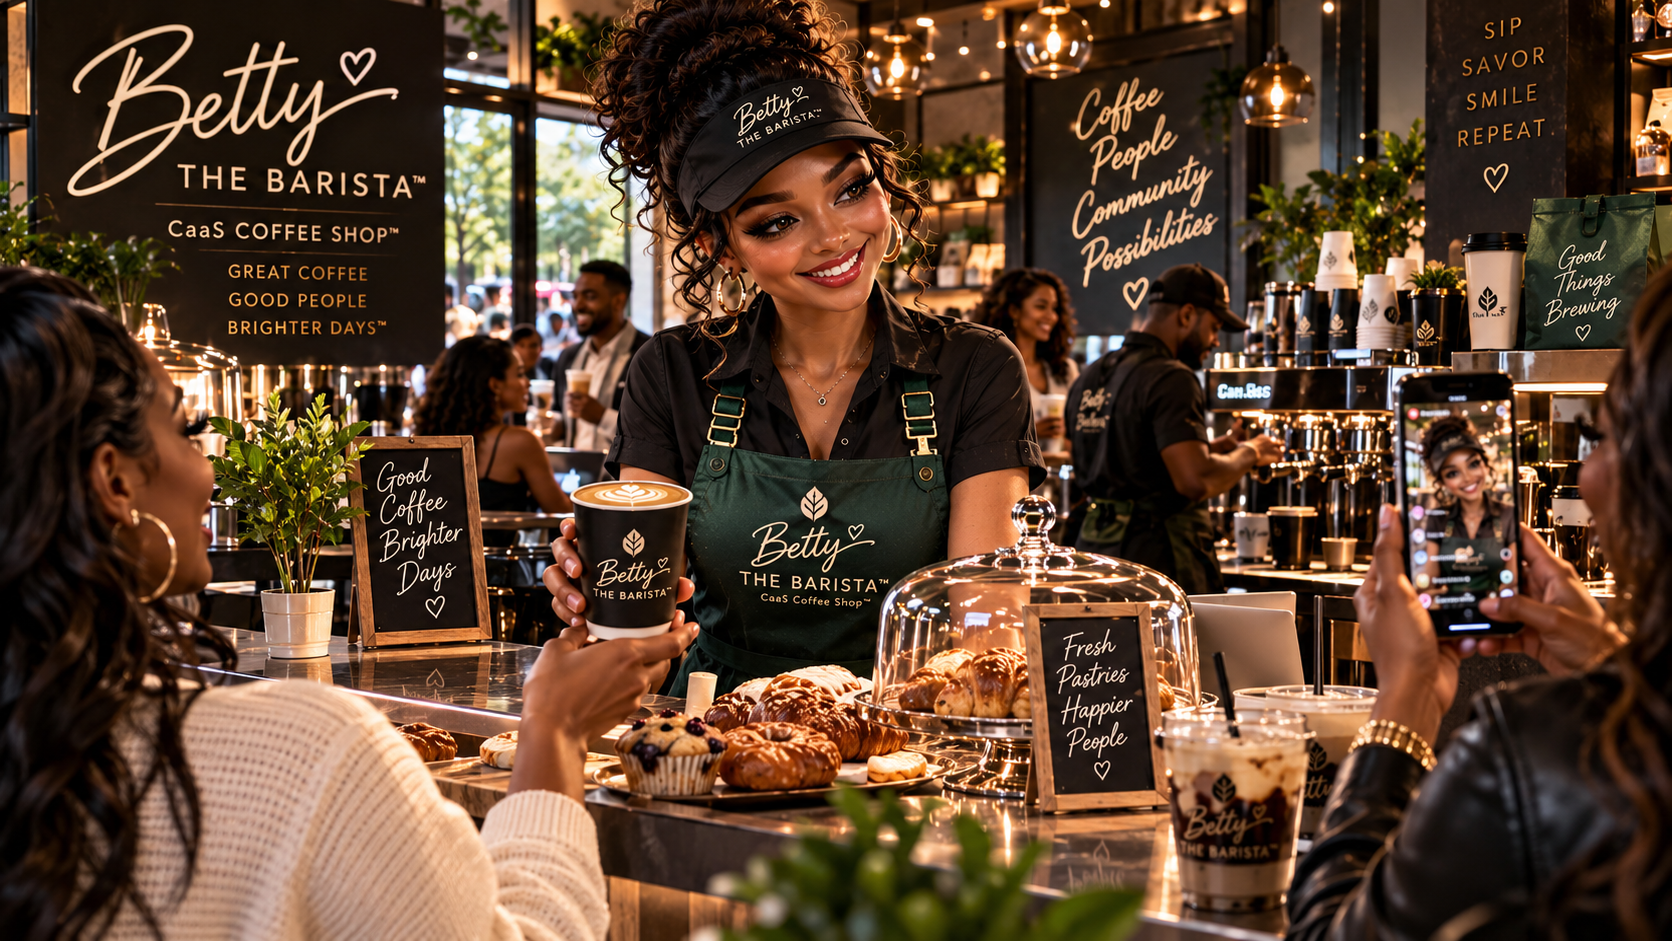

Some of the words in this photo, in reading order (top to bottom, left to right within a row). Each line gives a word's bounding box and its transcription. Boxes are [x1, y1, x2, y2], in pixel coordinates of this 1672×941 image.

[1484, 16, 1522, 40] SIP
[1461, 46, 1545, 77] SAVOR
[67, 23, 399, 197] Betty
[1075, 77, 1164, 140] Coffee
[1466, 83, 1538, 111] SMILE
[733, 93, 810, 137] Betty
[736, 131, 762, 148] THE
[1457, 118, 1546, 148] REPEAT
[1089, 113, 1179, 186] People
[177, 163, 247, 192] THE
[1072, 155, 1213, 240] Community
[167, 219, 225, 240] CaaS
[235, 221, 323, 243] COFFEE
[1080, 207, 1219, 288] Possibilities
[1557, 239, 1608, 272] Good
[228, 263, 291, 281] GREAT
[298, 265, 368, 282] COFFEE
[1553, 270, 1616, 298] Things
[228, 292, 289, 309] GOOD
[298, 293, 367, 309] PEOPLE
[1543, 296, 1622, 327] Brewing
[227, 320, 324, 336] BRIGHTER
[376, 456, 432, 494] Good
[379, 488, 448, 526] Coffee
[379, 521, 463, 563] Brighter
[751, 521, 876, 573] Betty
[396, 560, 457, 596] Days
[596, 558, 671, 590] Betty
[739, 570, 781, 589] THE
[593, 587, 615, 600] THE
[760, 592, 789, 604] CaaS
[792, 595, 830, 607] Coffee
[1063, 628, 1117, 662] Fresh
[1056, 661, 1130, 695] Pastries
[1060, 693, 1134, 729] Happier
[1066, 721, 1129, 759] People
[1183, 804, 1275, 845] Betty
[1180, 840, 1205, 858] THE
